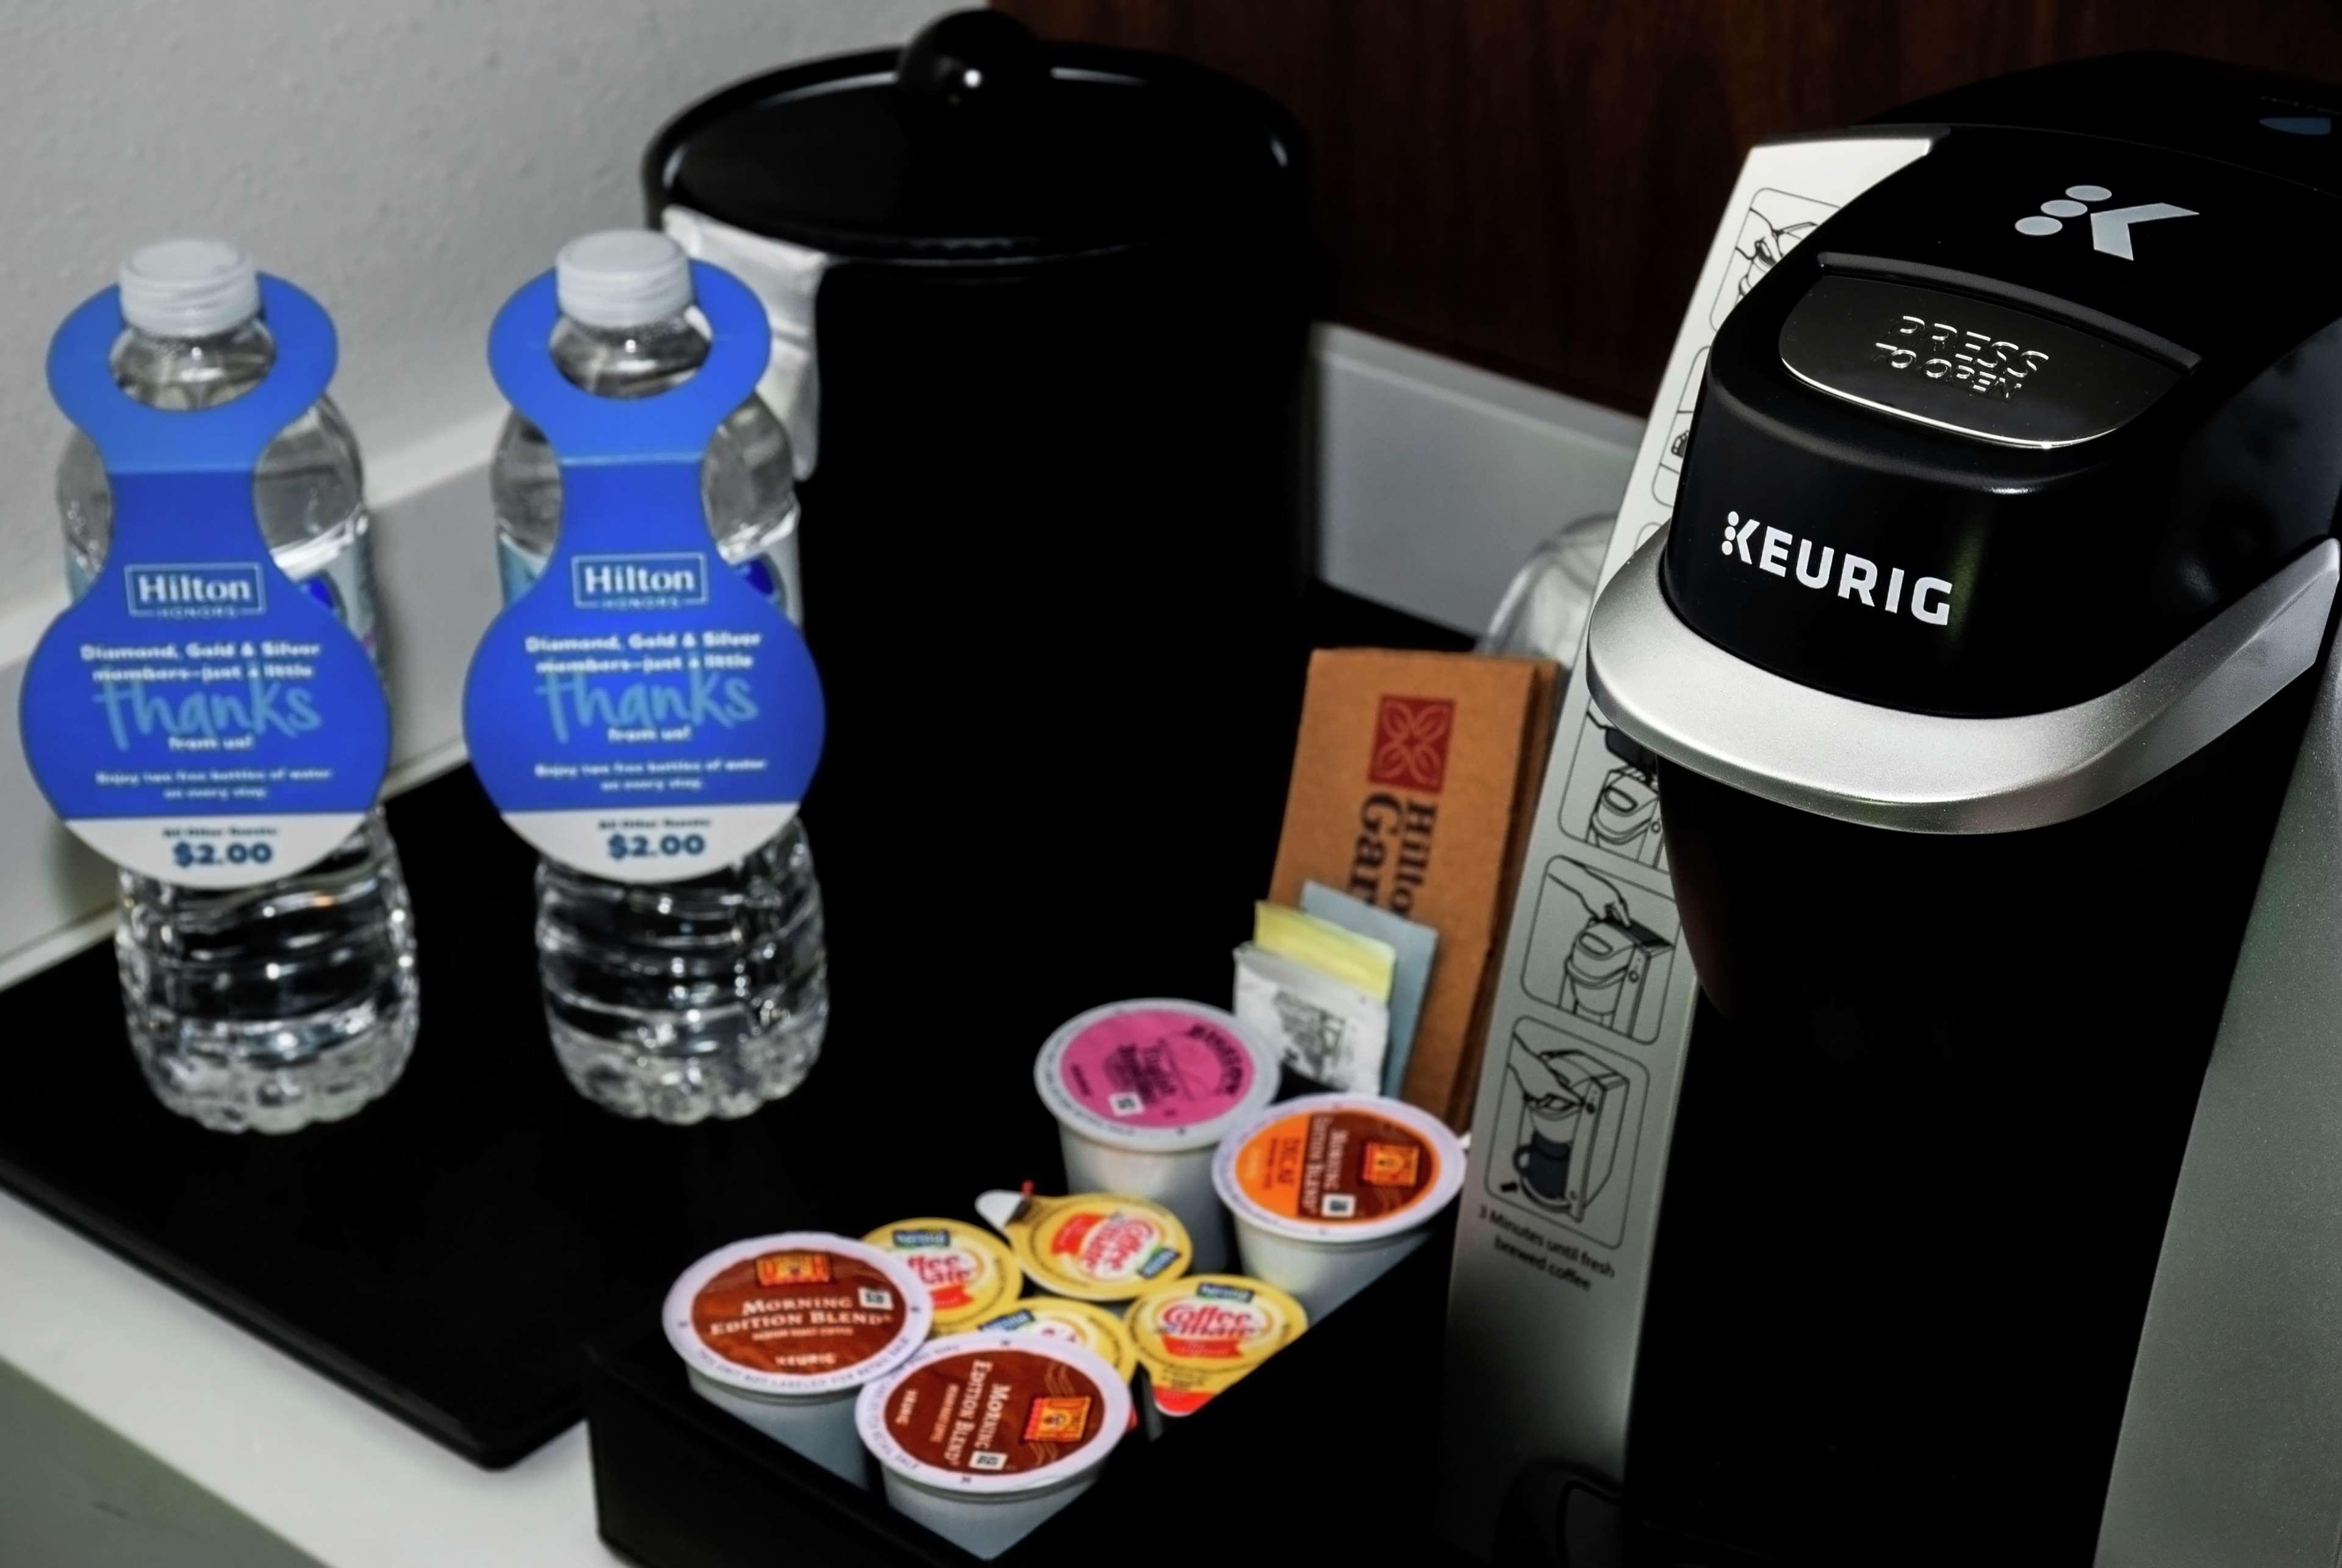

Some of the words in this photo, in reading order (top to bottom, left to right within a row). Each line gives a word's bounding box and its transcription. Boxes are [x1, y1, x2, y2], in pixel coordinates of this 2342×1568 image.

[1891, 315, 2049, 378] PRESS
[1872, 342, 1917, 369] TO
[1920, 358, 2024, 401] OPEN
[584, 565, 695, 594] Hilton
[1722, 511, 1953, 626] KEURIG
[138, 574, 251, 603] Hilton
[80, 642, 179, 661] Diamond,
[184, 642, 235, 659] Gold
[241, 641, 254, 657] &
[260, 640, 321, 658] Silver
[525, 634, 622, 653] Diamond,
[627, 633, 677, 650] Gold
[682, 632, 696, 648] &
[702, 630, 762, 648] Silver
[263, 663, 314, 678] little
[703, 653, 754, 669] little
[168, 736, 218, 751] from
[223, 735, 254, 750] us!
[606, 728, 656, 743] from
[661, 727, 692, 742] us!
[95, 771, 139, 786] Enjoy
[143, 772, 172, 783] two
[175, 770, 207, 782] free
[210, 769, 265, 782] bottles
[269, 768, 285, 780] of
[289, 768, 333, 780] water
[534, 763, 578, 779] Enjoy
[581, 764, 609, 776] two
[614, 763, 644, 774] free
[647, 760, 701, 773] bottles
[705, 760, 723, 771] of
[725, 758, 768, 771] water
[187, 789, 229, 801] every
[624, 780, 664, 793] every
[173, 841, 273, 868] $2.00
[608, 833, 706, 860] $2.00
[1277, 1138, 1301, 1185] DECAF
[1324, 1129, 1350, 1190] MORNING
[1489, 1210, 1545, 1247] Minutes
[1546, 1238, 1580, 1262] until
[1581, 1251, 1616, 1279] fresh
[1494, 1234, 1548, 1272] brewed
[1547, 1263, 1592, 1293] coffee
[742, 1295, 853, 1316] MORNING
[1163, 1304, 1252, 1328] Coffee
[709, 1310, 804, 1336] EDITION
[775, 1353, 836, 1367] KEURIG
[958, 1359, 993, 1421] EDITION
[974, 1382, 1012, 1450] MORNING
